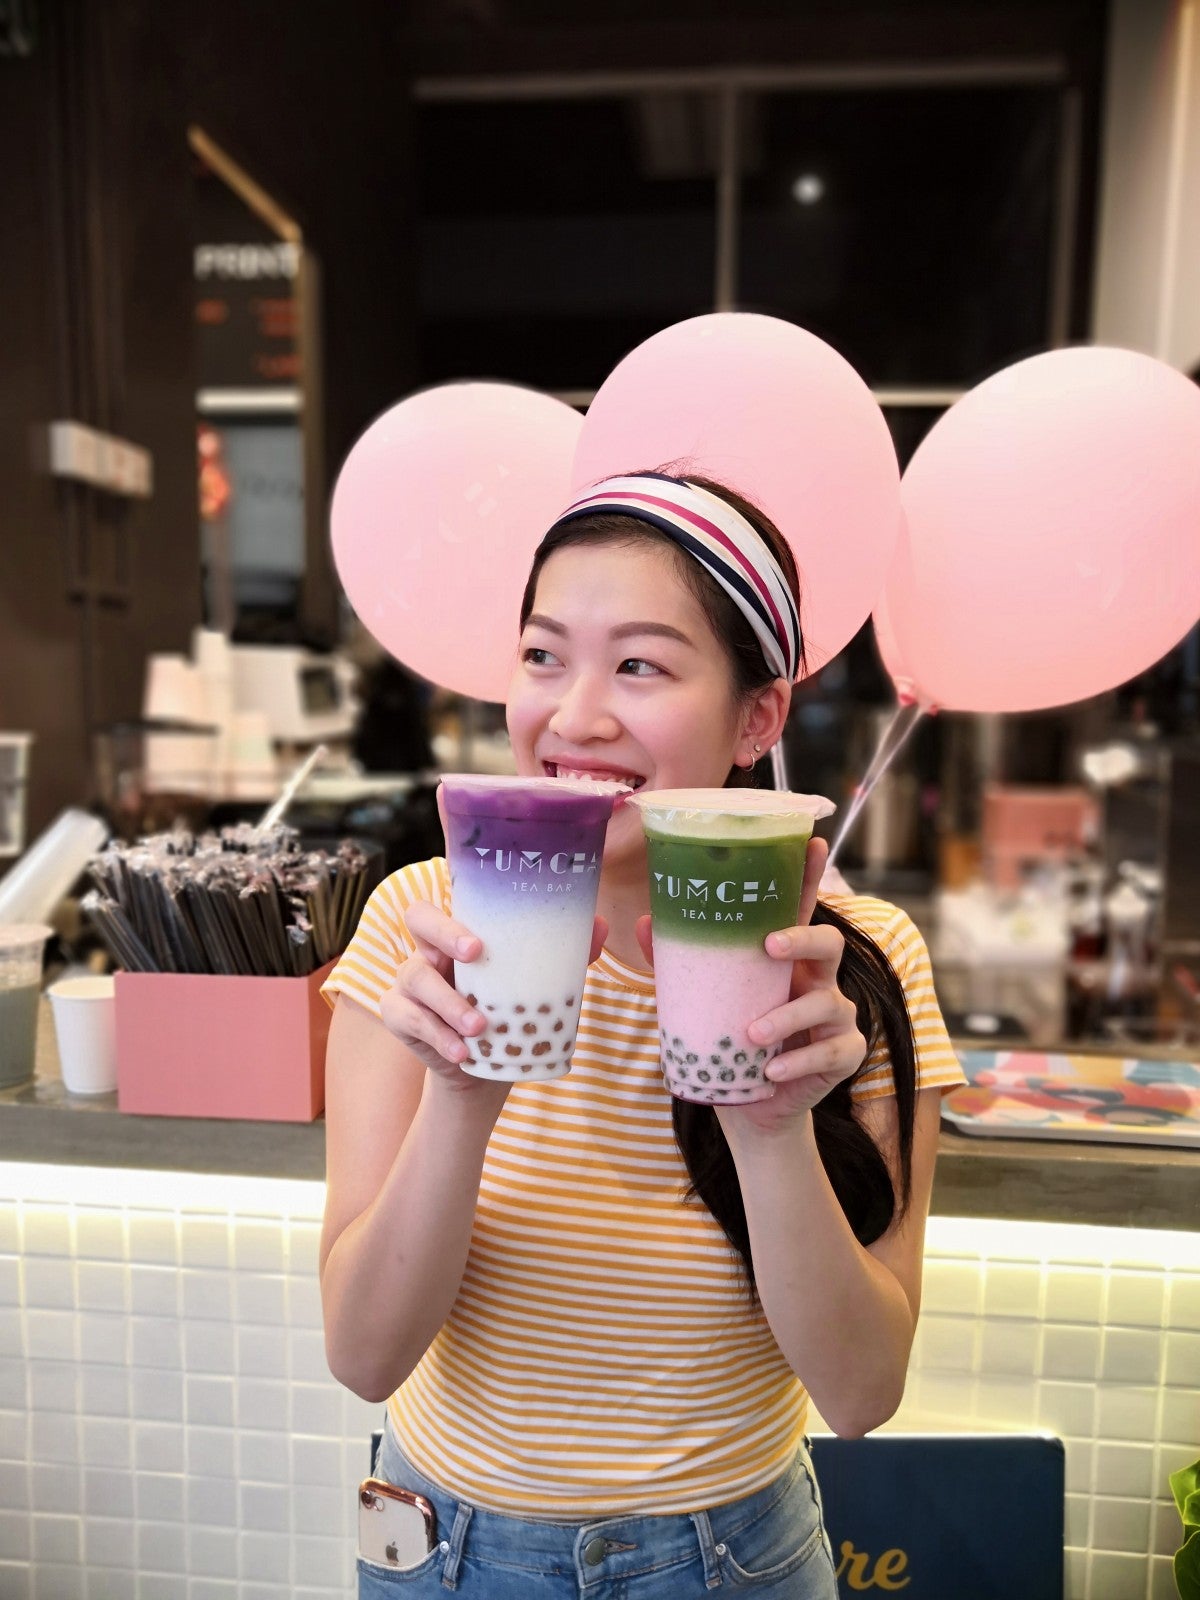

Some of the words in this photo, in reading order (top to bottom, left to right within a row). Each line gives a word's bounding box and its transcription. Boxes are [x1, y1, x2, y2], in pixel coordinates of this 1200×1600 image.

[474, 847, 598, 875] YUMCHA
[512, 881, 538, 893] TEA
[546, 883, 572, 893] BAR
[653, 871, 779, 903] YUMCHA
[681, 907, 707, 920] TEA
[714, 911, 744, 922] BAR
